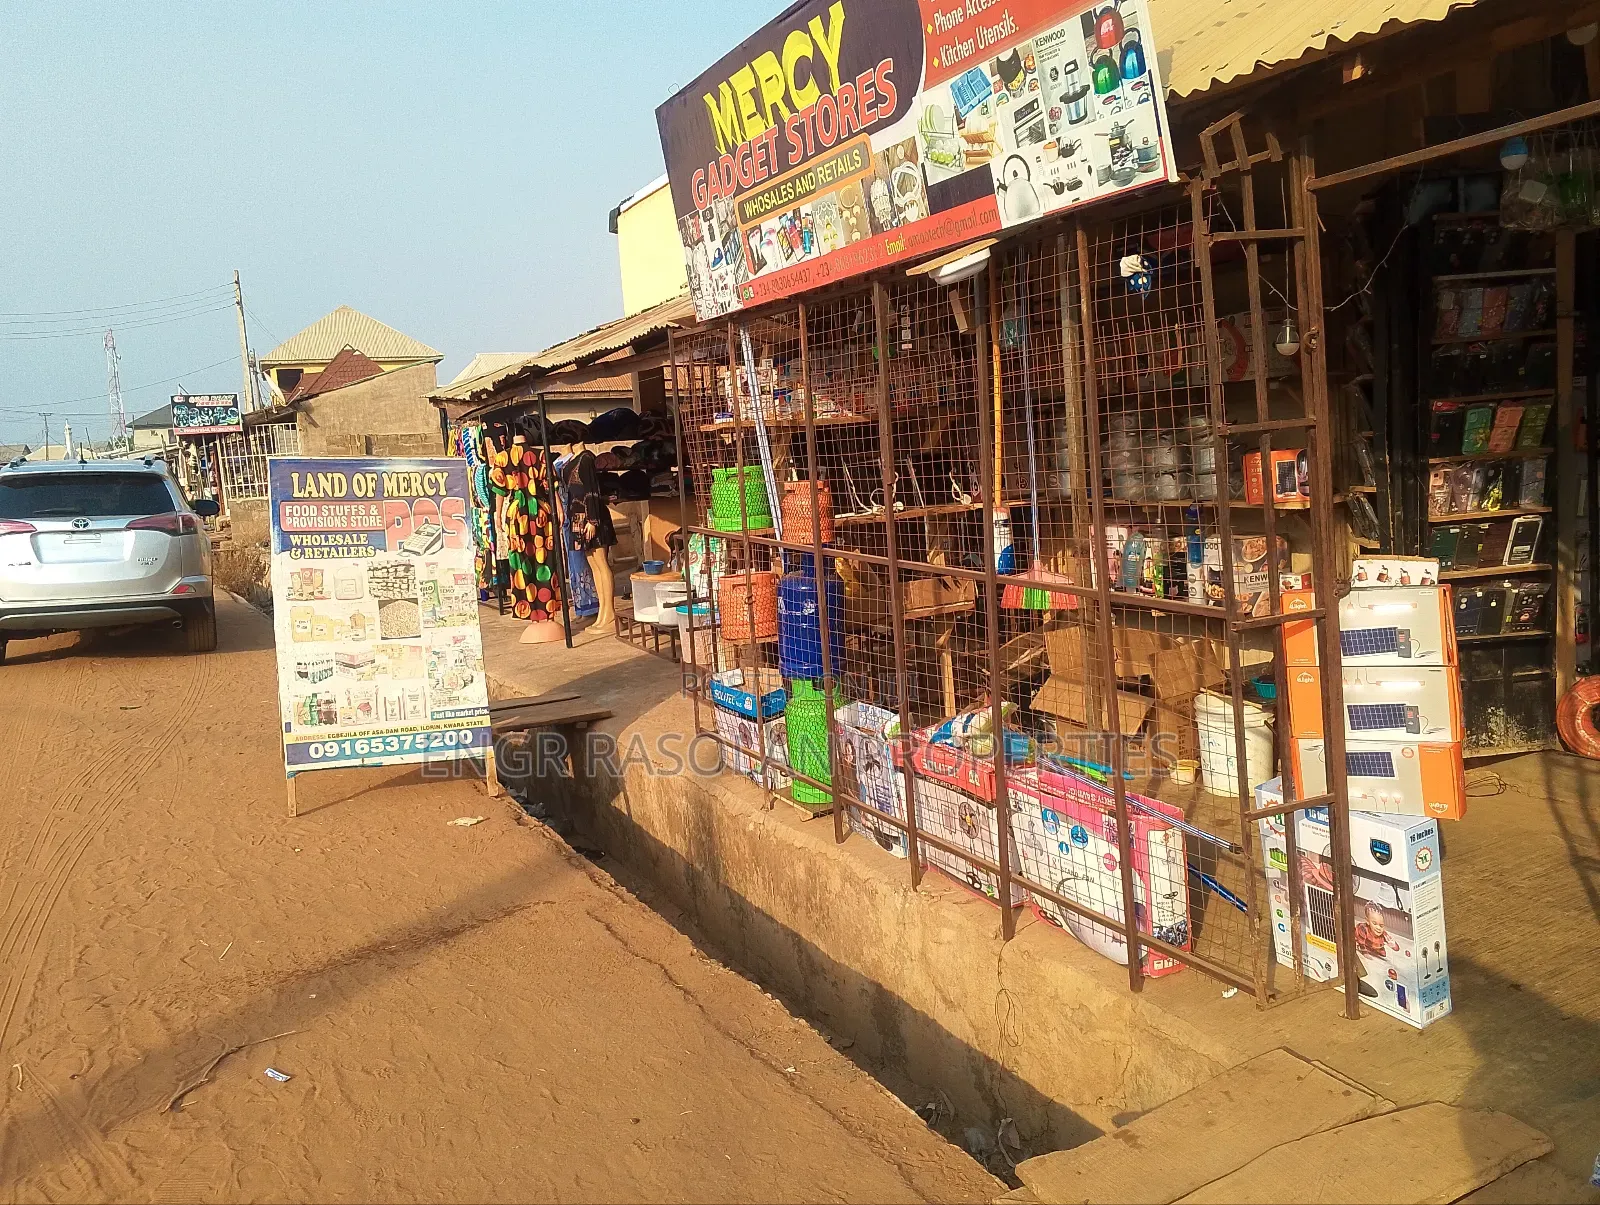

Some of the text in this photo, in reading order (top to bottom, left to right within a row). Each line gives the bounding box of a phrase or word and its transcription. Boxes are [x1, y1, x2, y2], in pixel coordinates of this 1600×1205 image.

[933, 6, 964, 36] Phone
[939, 8, 1020, 69] Kitchen Utensils.
[1035, 28, 1066, 48] KENWOOD
[703, 0, 845, 154] MERCY
[691, 57, 898, 211] GADGET STORES
[743, 149, 862, 219] WHOSALES AND RETAILS
[885, 233, 907, 257] Email:
[290, 471, 450, 498] LAND OF MERCY
[285, 504, 379, 517] FOOD STUFFS &
[285, 516, 383, 528] PROVISIONS STORE
[382, 496, 468, 553] POS
[290, 533, 369, 546] WHOLESALE
[290, 546, 376, 560] & RETAILERS
[1243, 574, 1268, 584] KENW
[432, 711, 445, 720] Just
[456, 708, 473, 718] market
[295, 734, 326, 742] ADDRESS:
[400, 726, 419, 734] ROAD,
[420, 724, 443, 732] ILORIN,
[443, 721, 464, 729] KWARA
[308, 729, 474, 759] 09165375200
